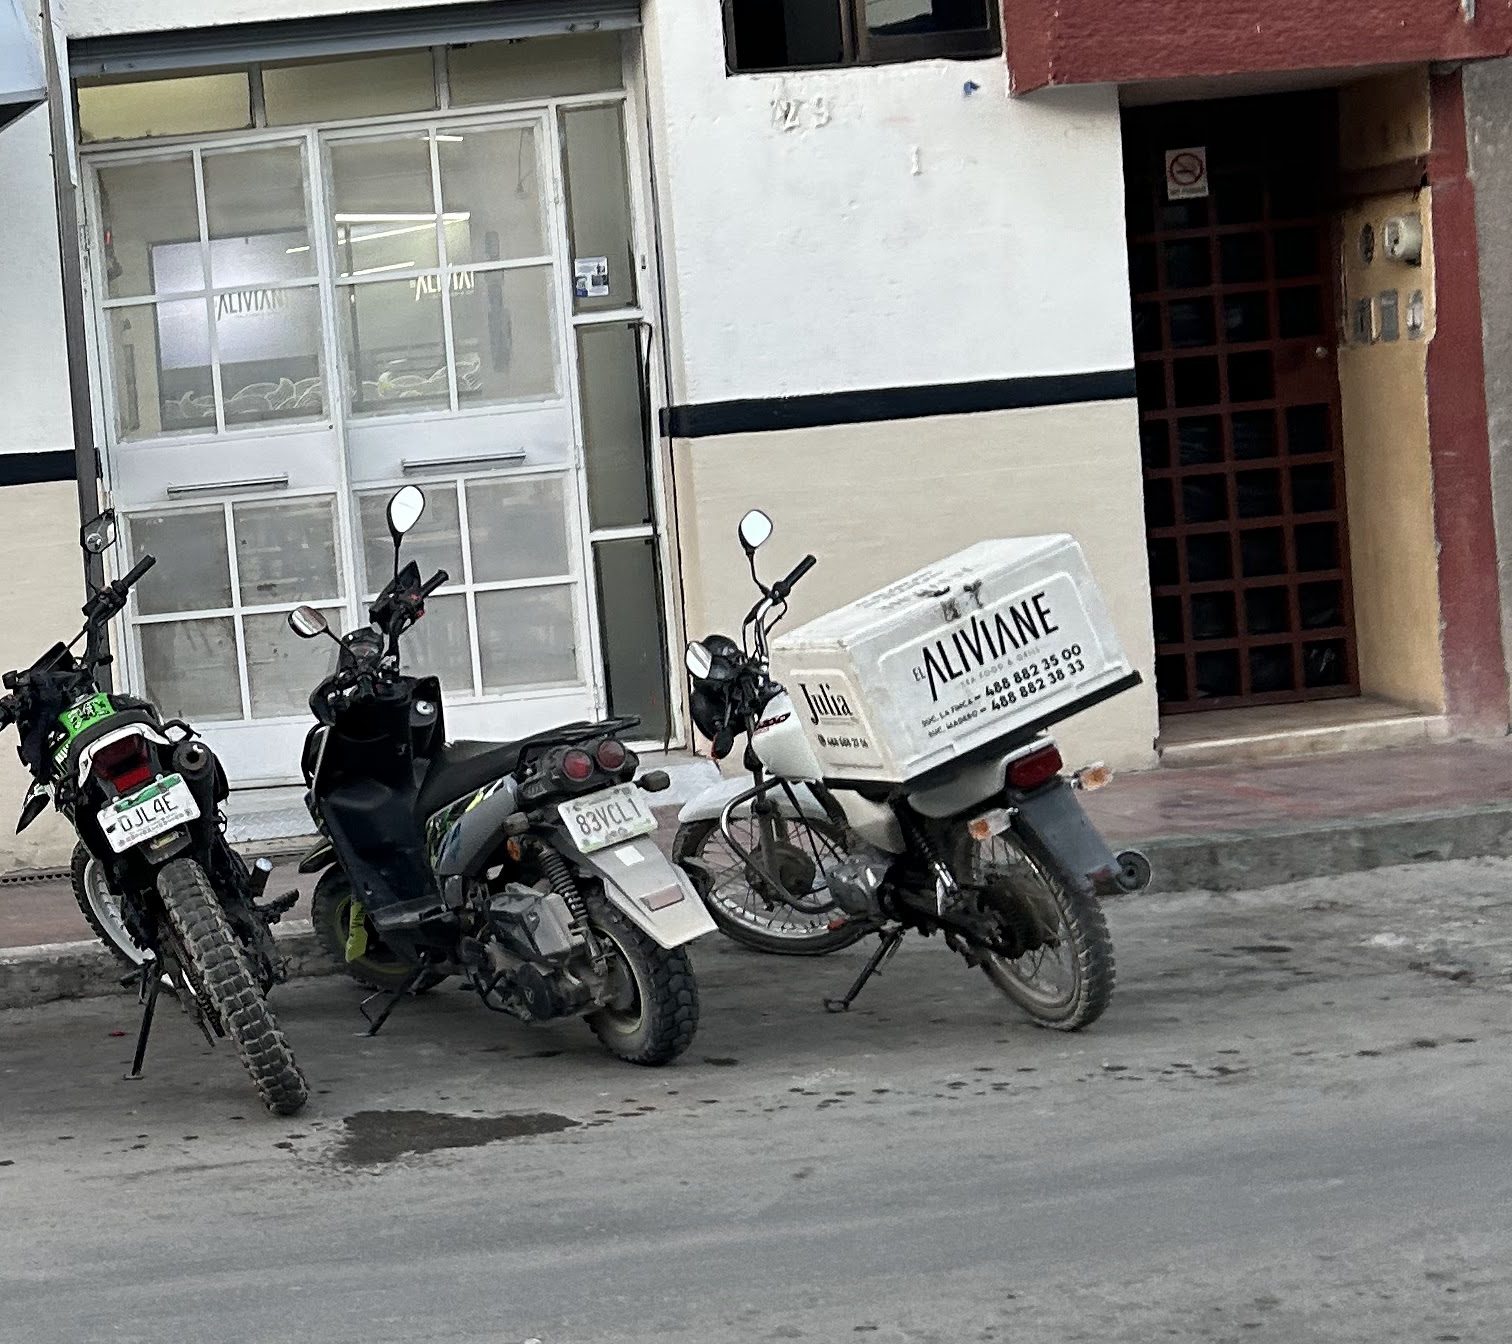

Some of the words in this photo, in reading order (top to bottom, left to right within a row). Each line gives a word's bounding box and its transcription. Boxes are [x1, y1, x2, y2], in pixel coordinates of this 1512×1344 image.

[912, 665, 927, 682] EL
[921, 591, 1059, 702] ALIVIANE
[985, 677, 1011, 698] 488
[1013, 663, 1039, 684] 882
[1041, 654, 1059, 671] 35
[1061, 643, 1082, 661] 00
[798, 682, 853, 725] Julia
[991, 690, 1017, 712] 488
[1019, 677, 1046, 698] 882
[1047, 667, 1065, 685] 38
[1067, 659, 1085, 676] 33
